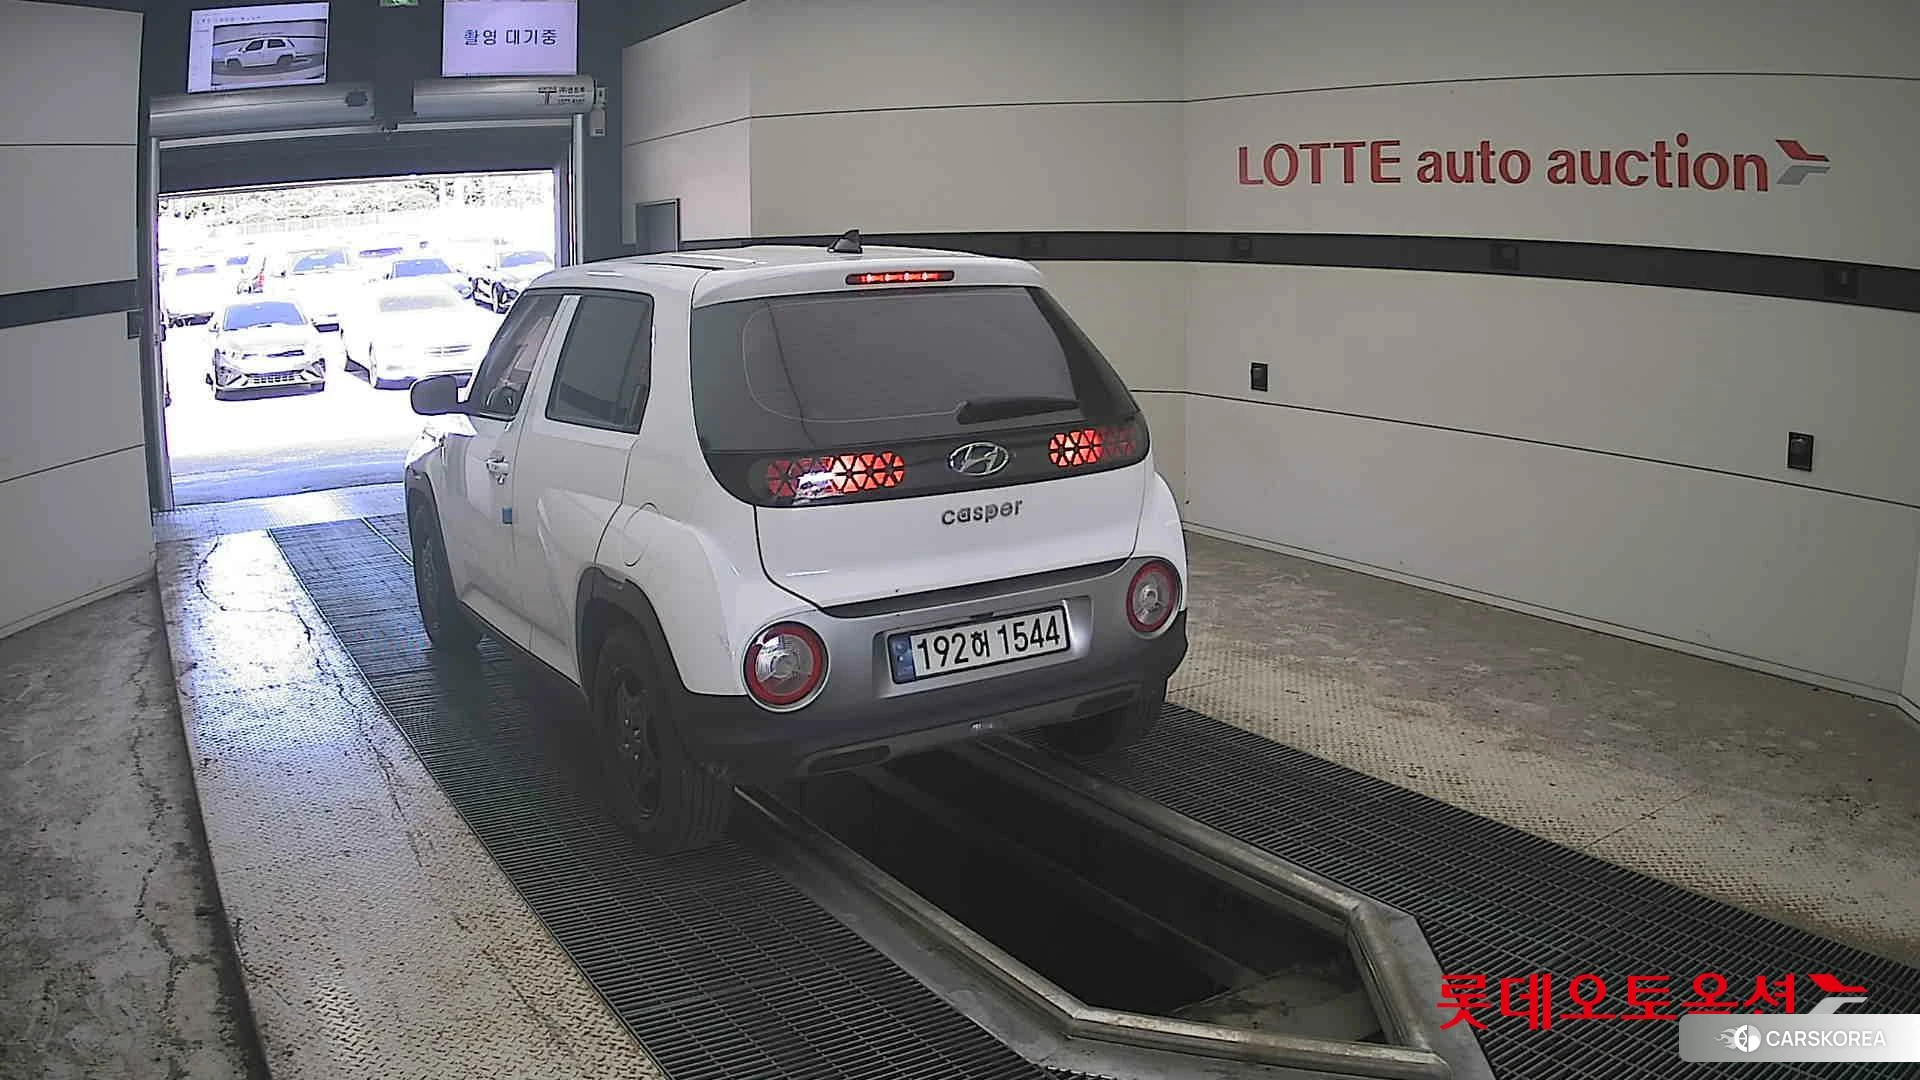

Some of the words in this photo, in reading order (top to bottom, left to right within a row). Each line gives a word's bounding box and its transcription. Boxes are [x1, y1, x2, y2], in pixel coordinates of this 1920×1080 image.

[464, 29, 497, 46] 촬영
[505, 29, 558, 46] 대기중
[1239, 139, 1401, 186] LOTTE
[1416, 141, 1532, 185] auto
[1547, 132, 1770, 193] auction
[941, 500, 1023, 526] casper
[917, 630, 991, 670] 192허
[997, 615, 1061, 655] 1544
